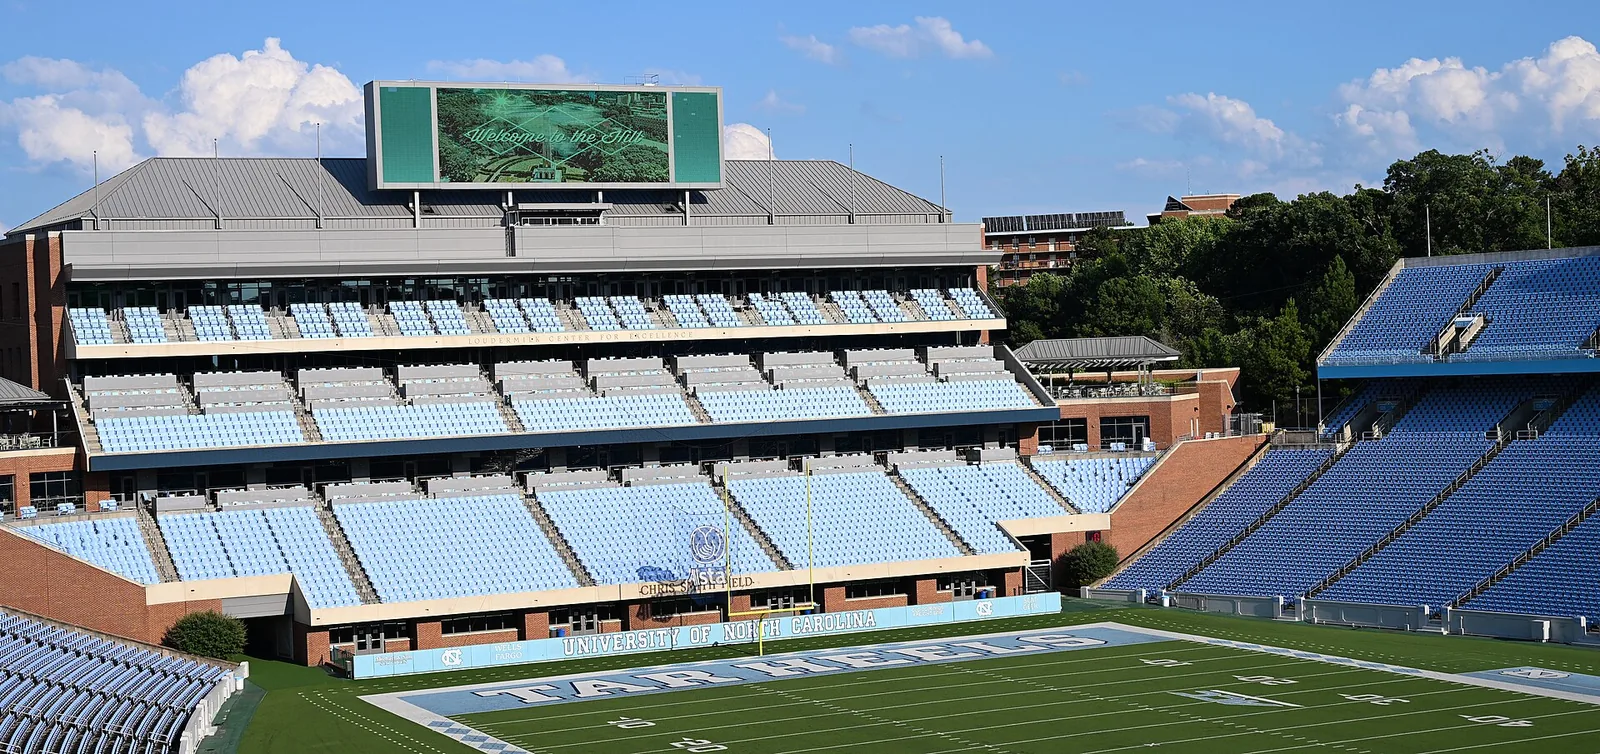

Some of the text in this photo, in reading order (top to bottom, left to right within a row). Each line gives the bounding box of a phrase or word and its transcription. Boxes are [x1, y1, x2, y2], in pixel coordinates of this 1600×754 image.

[467, 129, 643, 144] Welcome to the Hill
[468, 331, 693, 345] LOUDERMILK CENTER FOR EXCELLENCE
[640, 582, 675, 596] CHRIS
[562, 610, 876, 657] UNIVERSITY OF NORTH CAROLINA
[494, 643, 522, 651] WELLS
[494, 651, 523, 661] FARGO
[471, 634, 1108, 704] TAR HEELS
[1467, 715, 1534, 728] 40
[669, 739, 728, 753] 20
